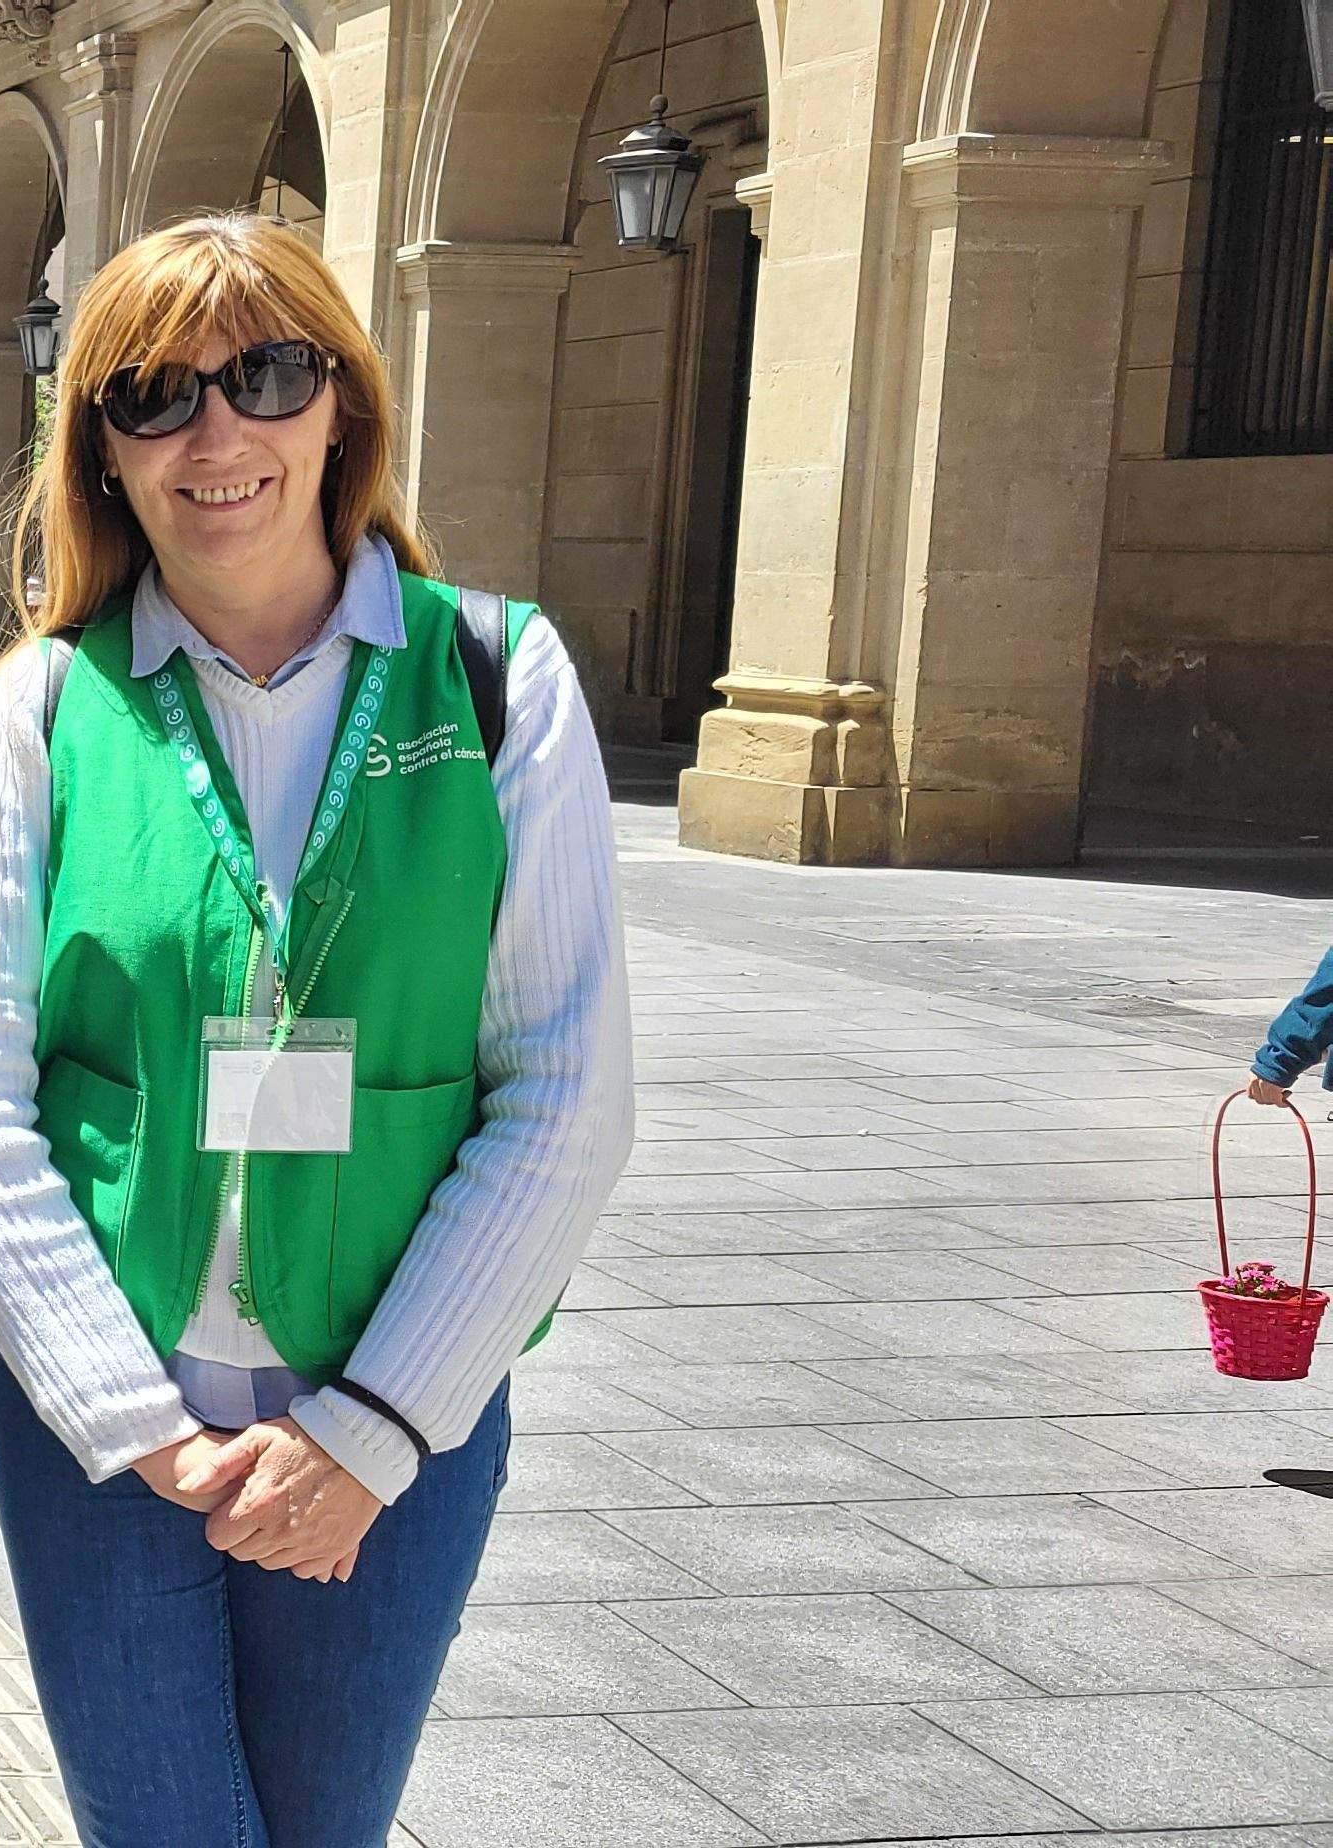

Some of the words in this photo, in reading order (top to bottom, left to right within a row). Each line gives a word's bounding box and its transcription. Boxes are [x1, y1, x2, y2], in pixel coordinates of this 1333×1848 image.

[396, 722, 459, 751] asociación
[398, 737, 452, 763] española
[399, 754, 438, 775] contra
[440, 748, 452, 760] el
